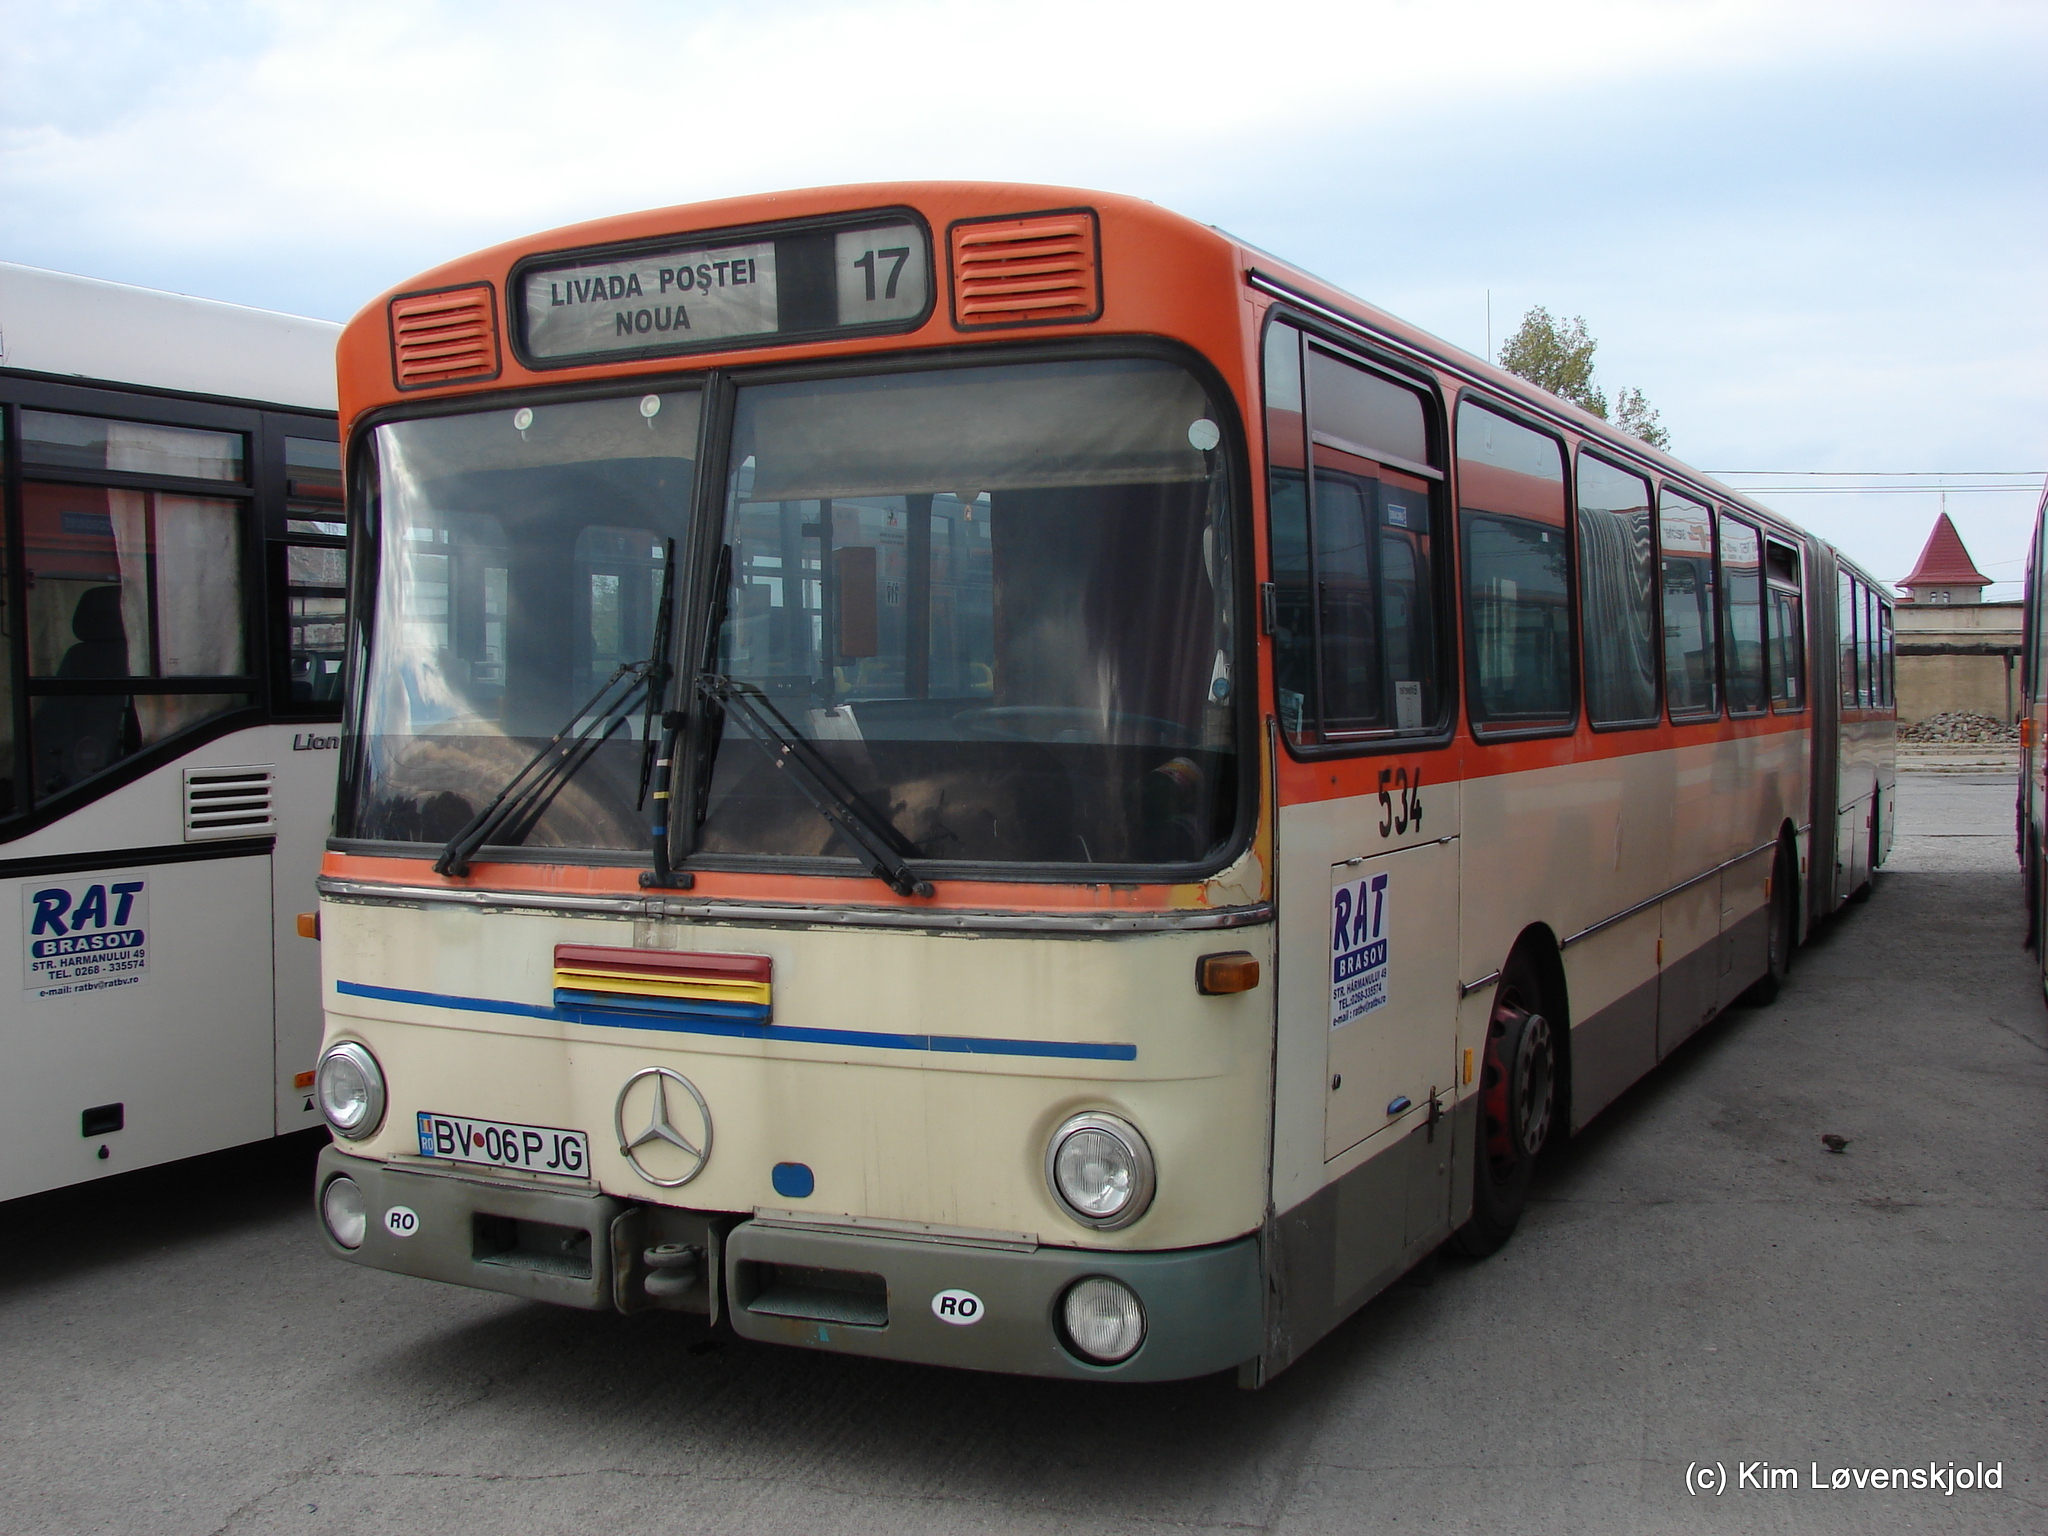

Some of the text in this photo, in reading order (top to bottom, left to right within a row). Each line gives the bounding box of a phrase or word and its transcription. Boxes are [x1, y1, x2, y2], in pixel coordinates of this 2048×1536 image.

[853, 247, 911, 302] 17
[551, 273, 643, 307] LIVADA
[616, 305, 691, 336] NOUA
[1378, 767, 1422, 837] 534
[31, 881, 144, 936] RAT
[1334, 873, 1388, 952] RAT
[43, 932, 136, 955] BRASOV
[32, 949, 145, 971] STR. HARMANULUI 49
[48, 970, 72, 980] TEL.
[75, 965, 100, 977] 0268
[109, 959, 145, 972] 335574
[1340, 944, 1383, 977] BRASOV
[40, 976, 139, 997] e-mail: ratbv@ratbv.ro
[1333, 986, 1345, 1000] STR.
[421, 1137, 434, 1150] RO
[390, 1212, 415, 1230] RO
[940, 1296, 977, 1317] RO
